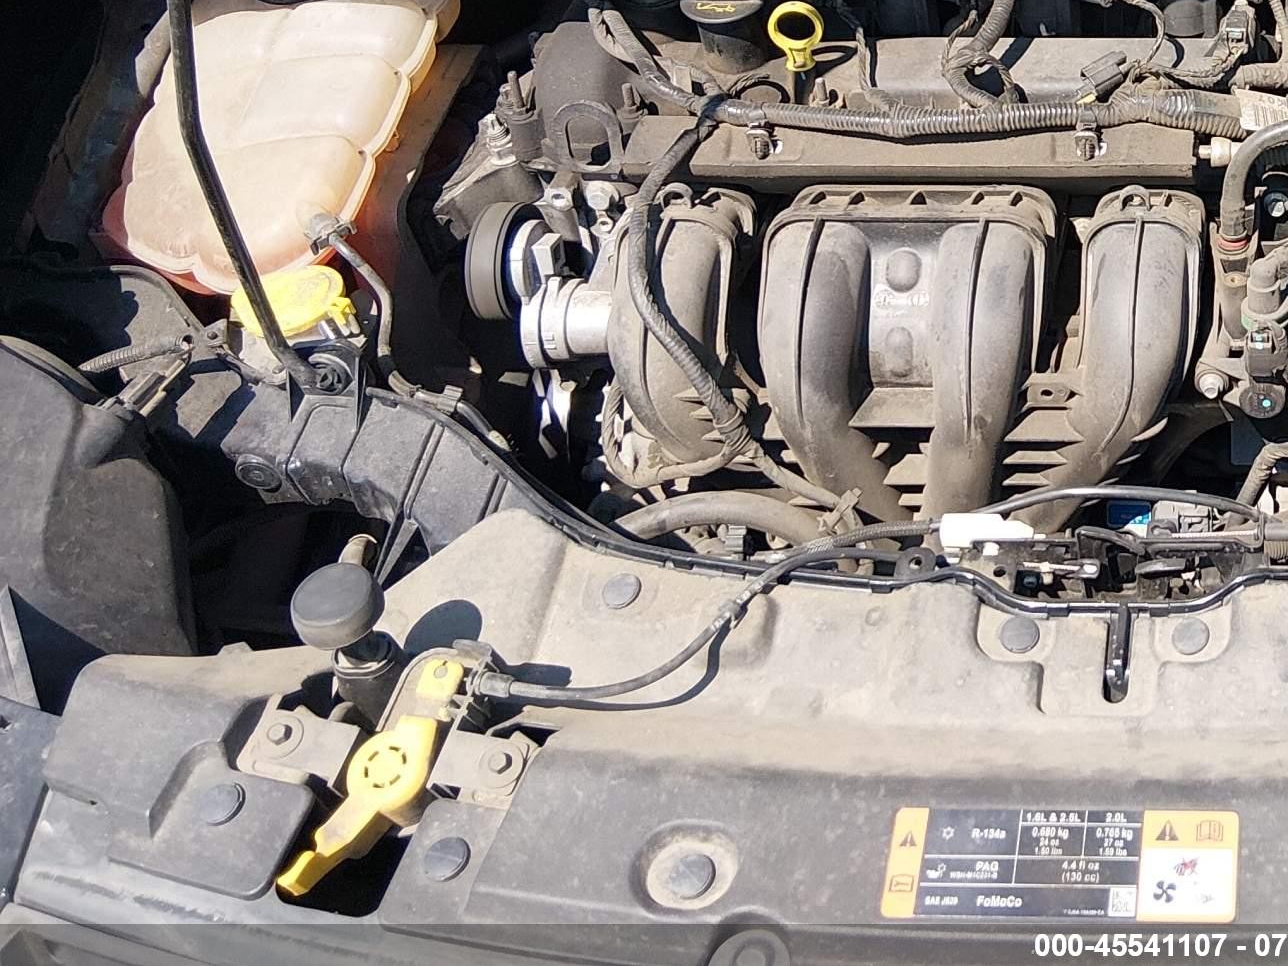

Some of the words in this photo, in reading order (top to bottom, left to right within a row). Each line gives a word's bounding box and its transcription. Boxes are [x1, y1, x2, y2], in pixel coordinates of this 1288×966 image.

[1026, 812, 1047, 822] 1.6L
[1049, 812, 1058, 822] &
[1105, 812, 1128, 823] 2.0L
[971, 828, 1007, 839] R-134a
[1058, 826, 1070, 840] kg
[1121, 827, 1133, 841] kg
[975, 861, 999, 871] PAG
[1061, 860, 1077, 870] 4.4
[1088, 862, 1100, 871] oz
[1061, 872, 1082, 883] (130
[1084, 872, 1100, 883] cc)
[924, 895, 941, 906] SAE
[976, 895, 1022, 908] FoMoCo
